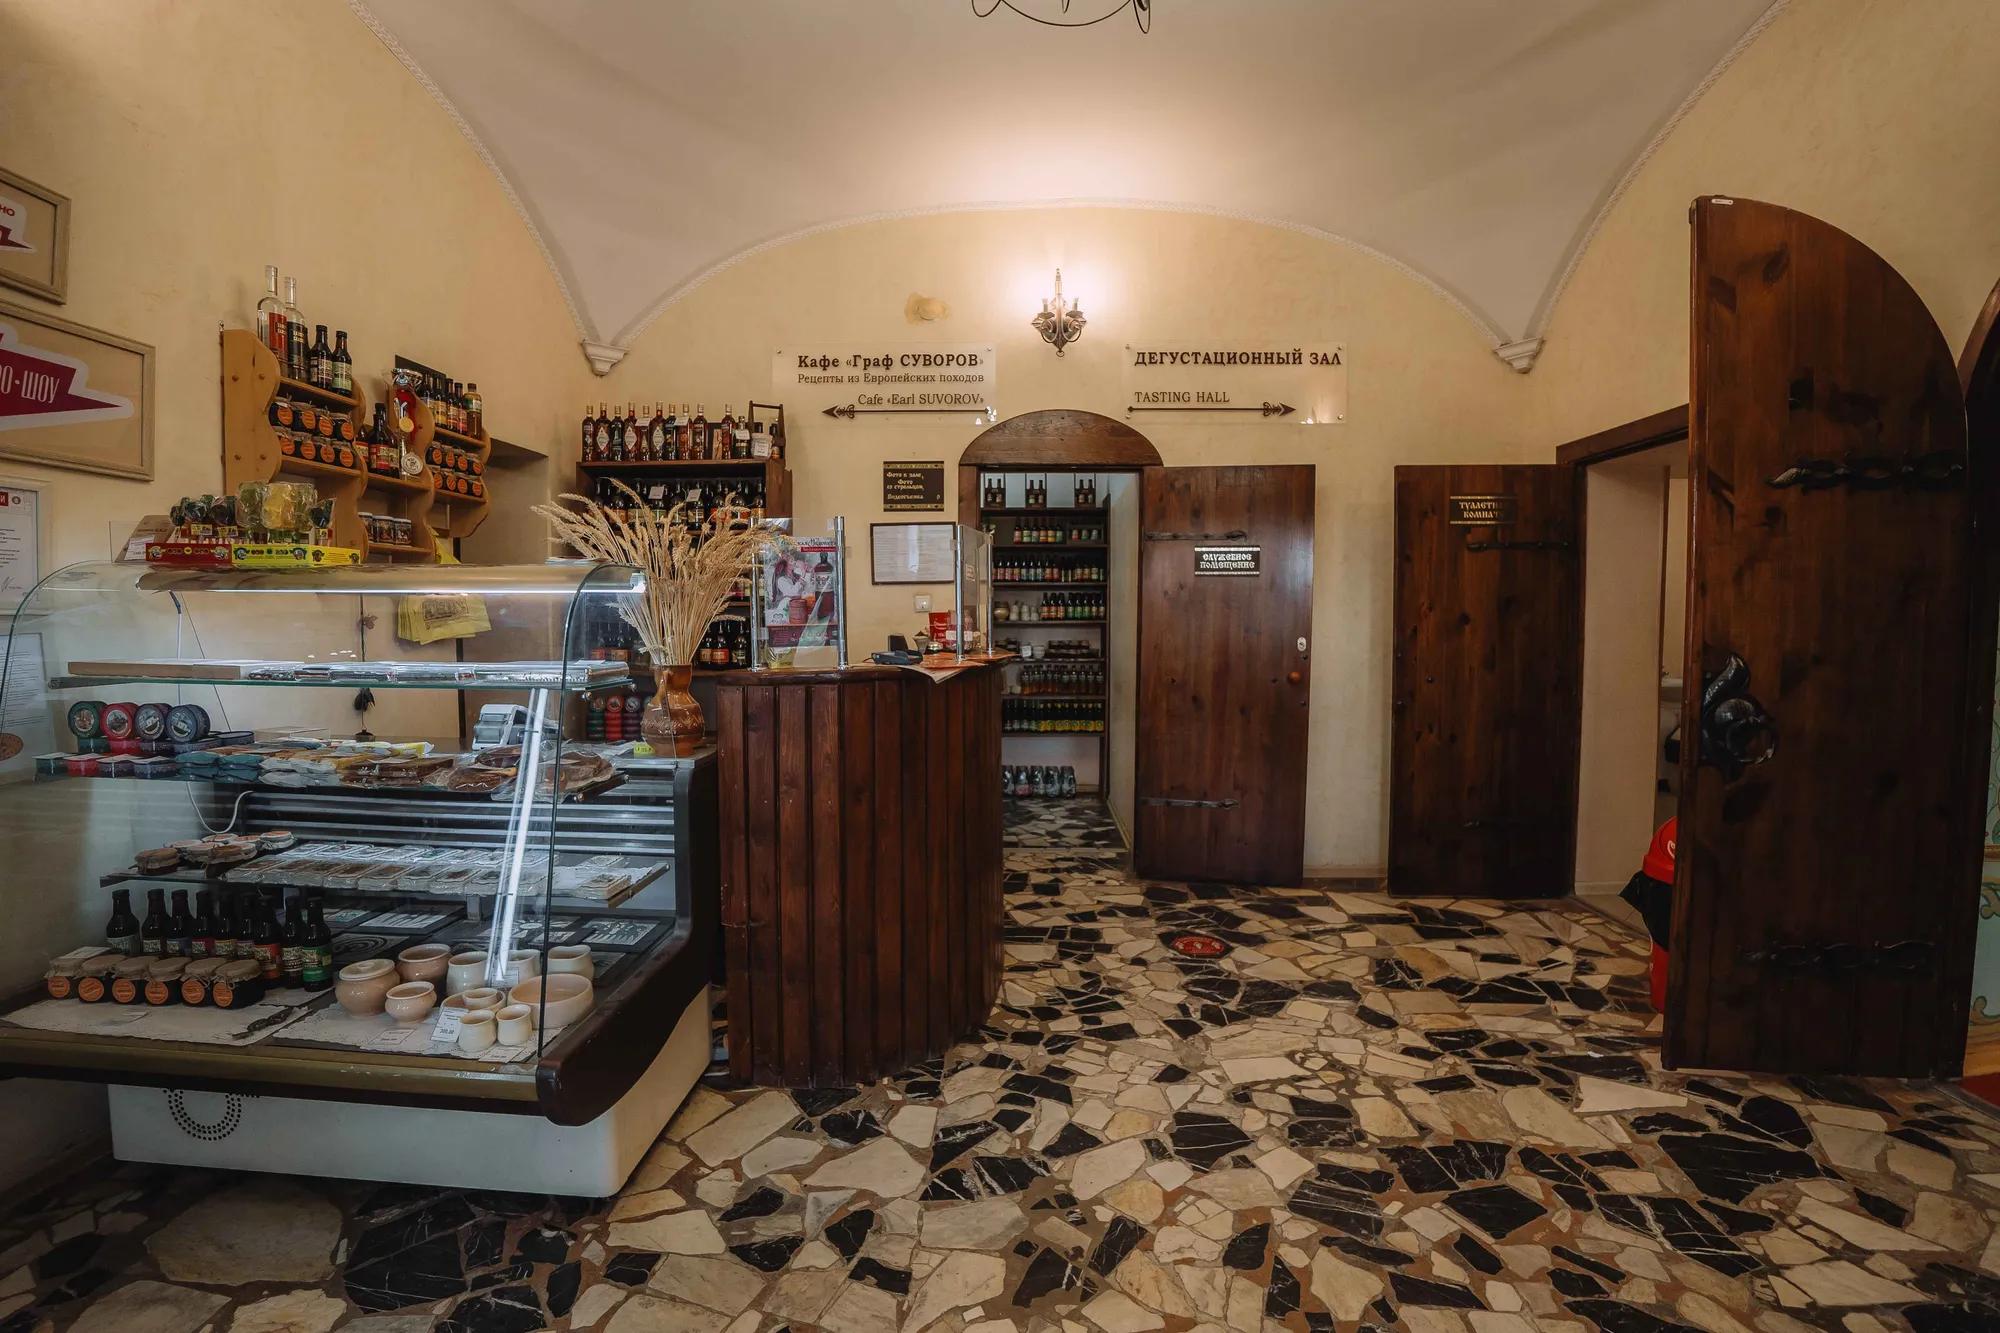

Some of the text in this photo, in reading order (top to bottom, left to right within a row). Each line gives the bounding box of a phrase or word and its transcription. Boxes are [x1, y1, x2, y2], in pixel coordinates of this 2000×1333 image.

[797, 353, 984, 371] Кафе «Граф СУВОРОВ»
[1134, 348, 1341, 367] ДЕГУСТАЦИОННЫЙ ЗАЛ
[797, 372, 984, 385] Рецепты из Европейских походов
[857, 393, 984, 406] Cafe «Earl SUVOROV»
[1134, 391, 1230, 403] TASTING HALL
[1459, 502, 1503, 510] ТУАЛЕТН
[1463, 511, 1502, 519] КОМНАТ
[1202, 553, 1252, 561] СЛУЖЕБНОЕ
[1200, 561, 1255, 570] ПОМЕЩЕНИЕ
